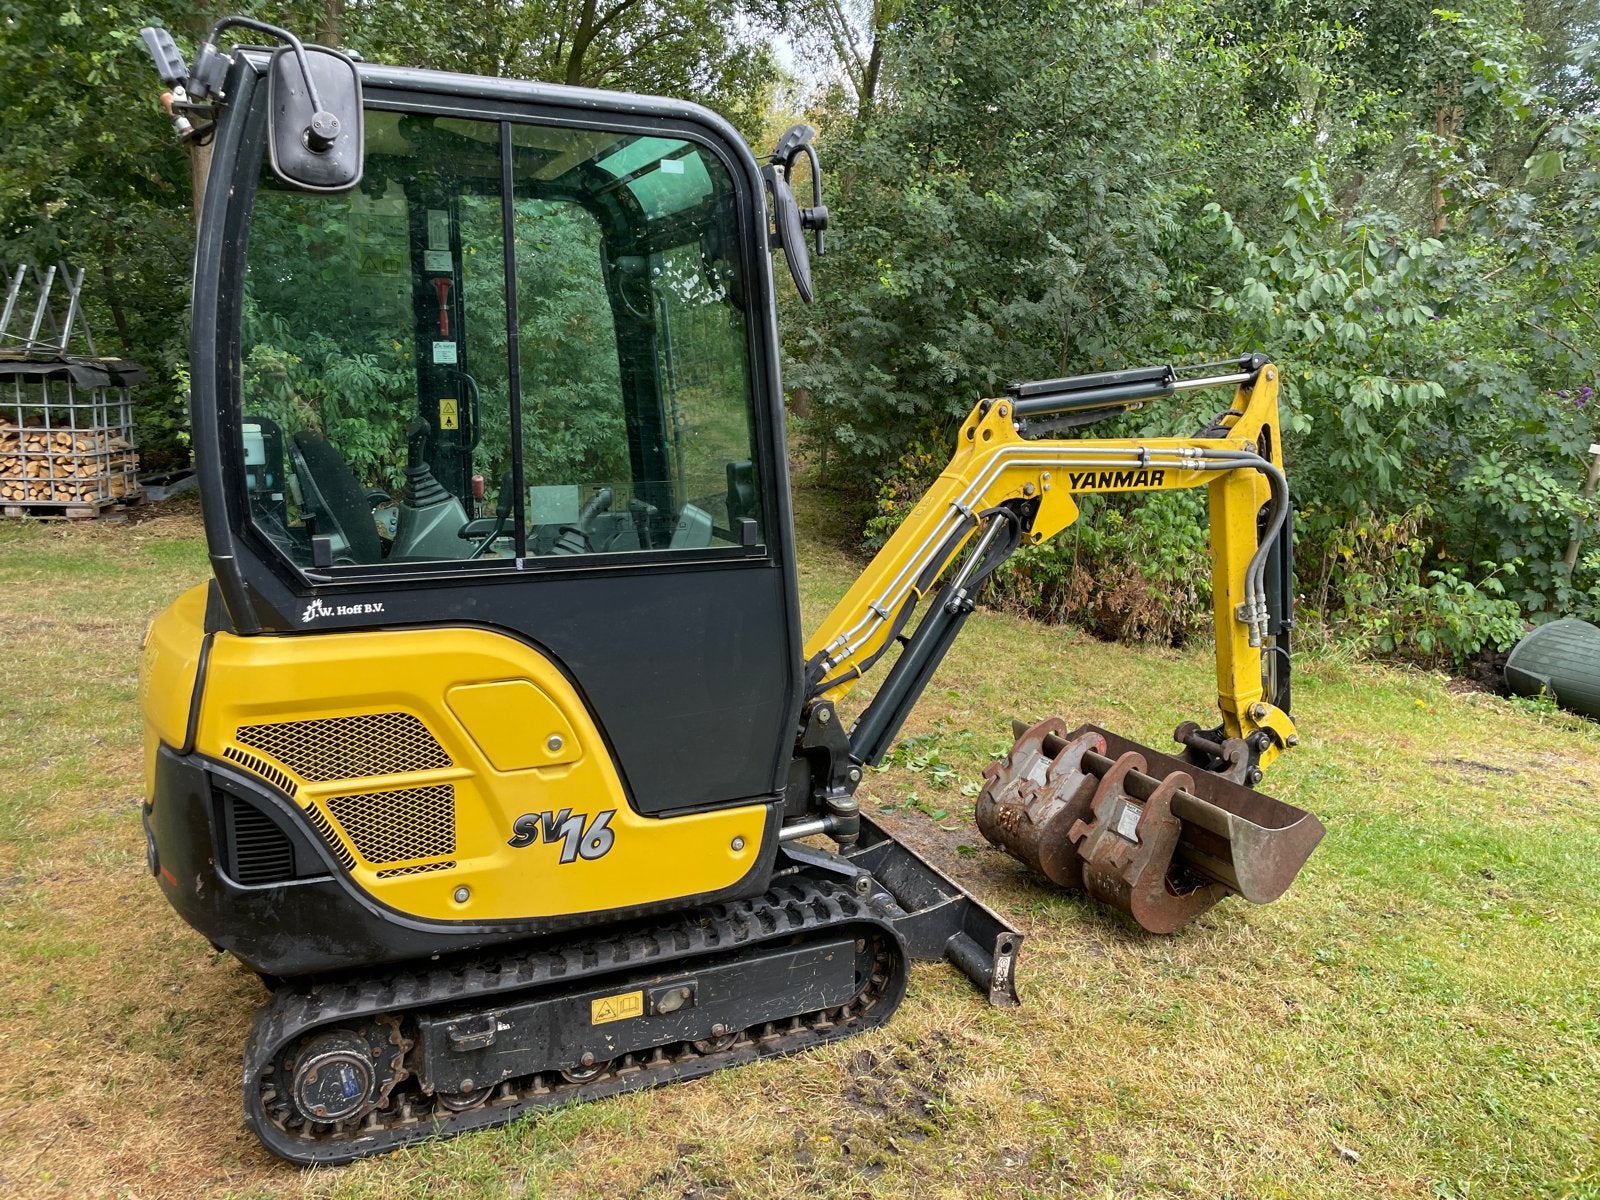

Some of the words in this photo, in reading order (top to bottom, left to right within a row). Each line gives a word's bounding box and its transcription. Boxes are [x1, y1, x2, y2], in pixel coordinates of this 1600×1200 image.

[1068, 469, 1165, 490] YANMAR
[336, 604, 363, 616] Hoff
[363, 602, 385, 613] B.V.
